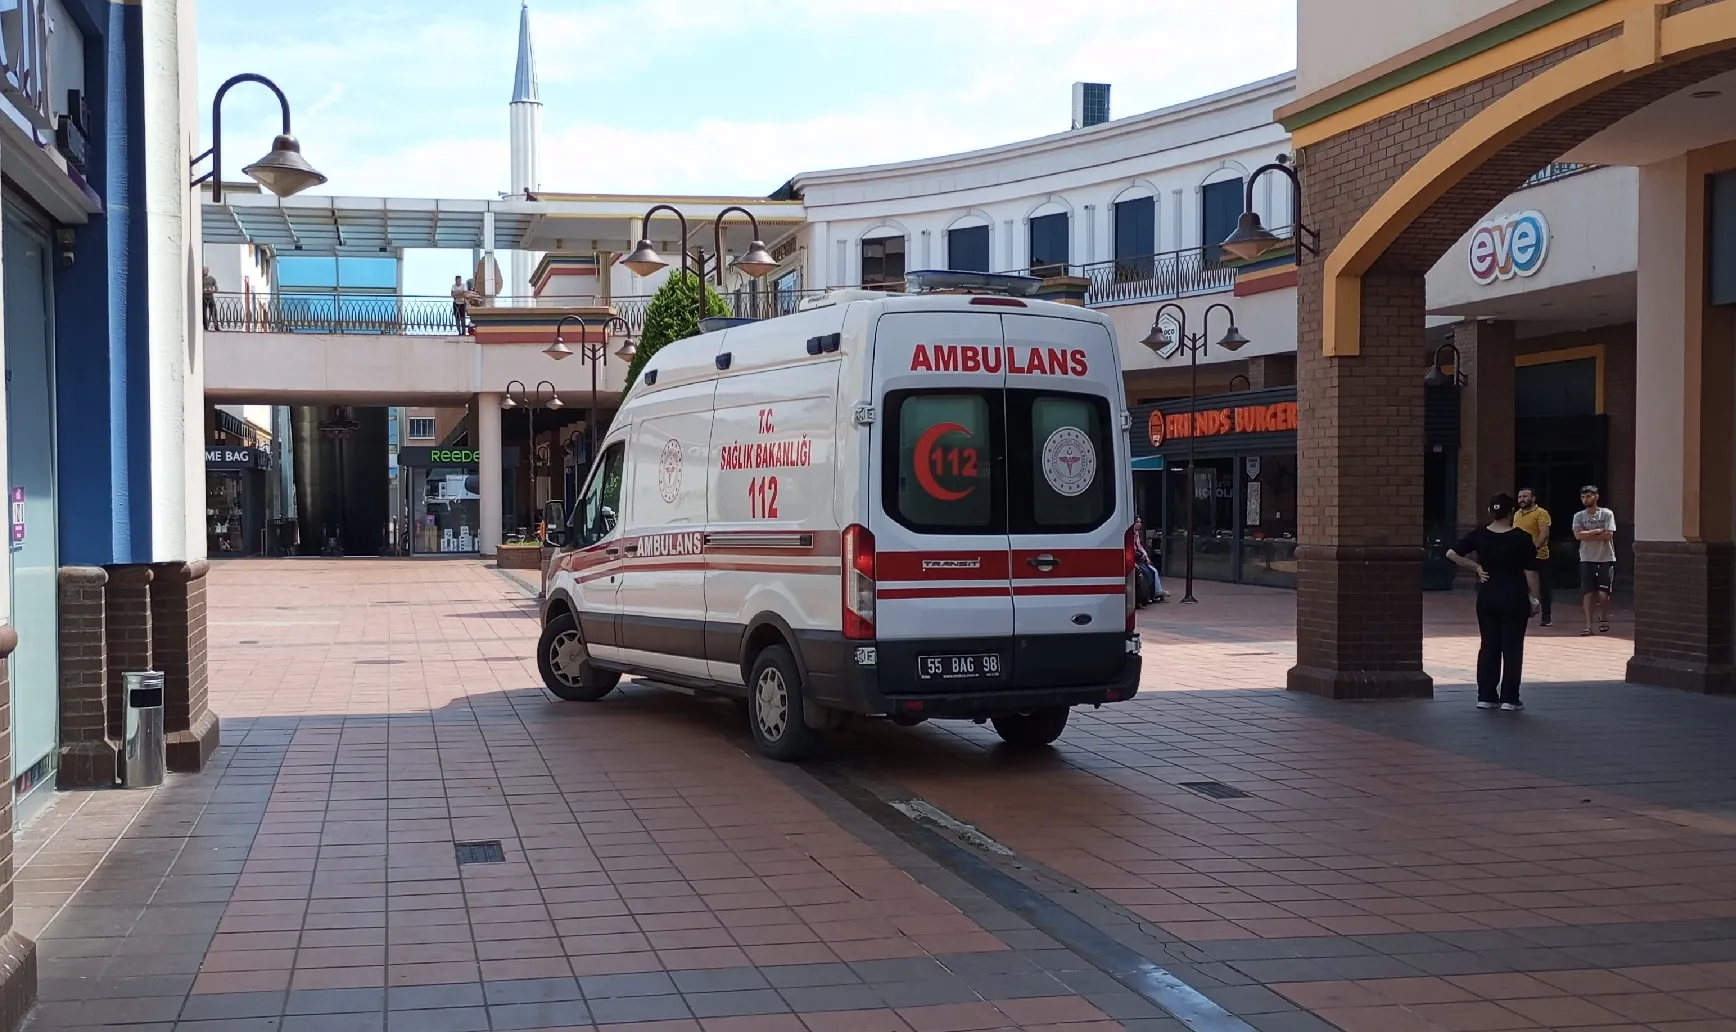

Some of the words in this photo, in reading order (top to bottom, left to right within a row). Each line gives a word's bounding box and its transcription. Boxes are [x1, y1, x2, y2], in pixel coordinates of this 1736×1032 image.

[1469, 215, 1545, 280] eve
[910, 344, 1089, 377] AMBULANS
[758, 408, 775, 435] T.C.
[1234, 402, 1297, 432] BURGER
[225, 450, 249, 462] BAG
[720, 440, 754, 471] SAĞLIK
[755, 433, 812, 469] BAKANLIĞI
[931, 446, 978, 477] 112
[748, 475, 778, 519] 112
[636, 532, 702, 557] AMBULANS
[923, 560, 980, 568] TRANSIT
[927, 658, 943, 674] 55
[952, 657, 975, 673] BAG
[983, 656, 998, 672] 98
